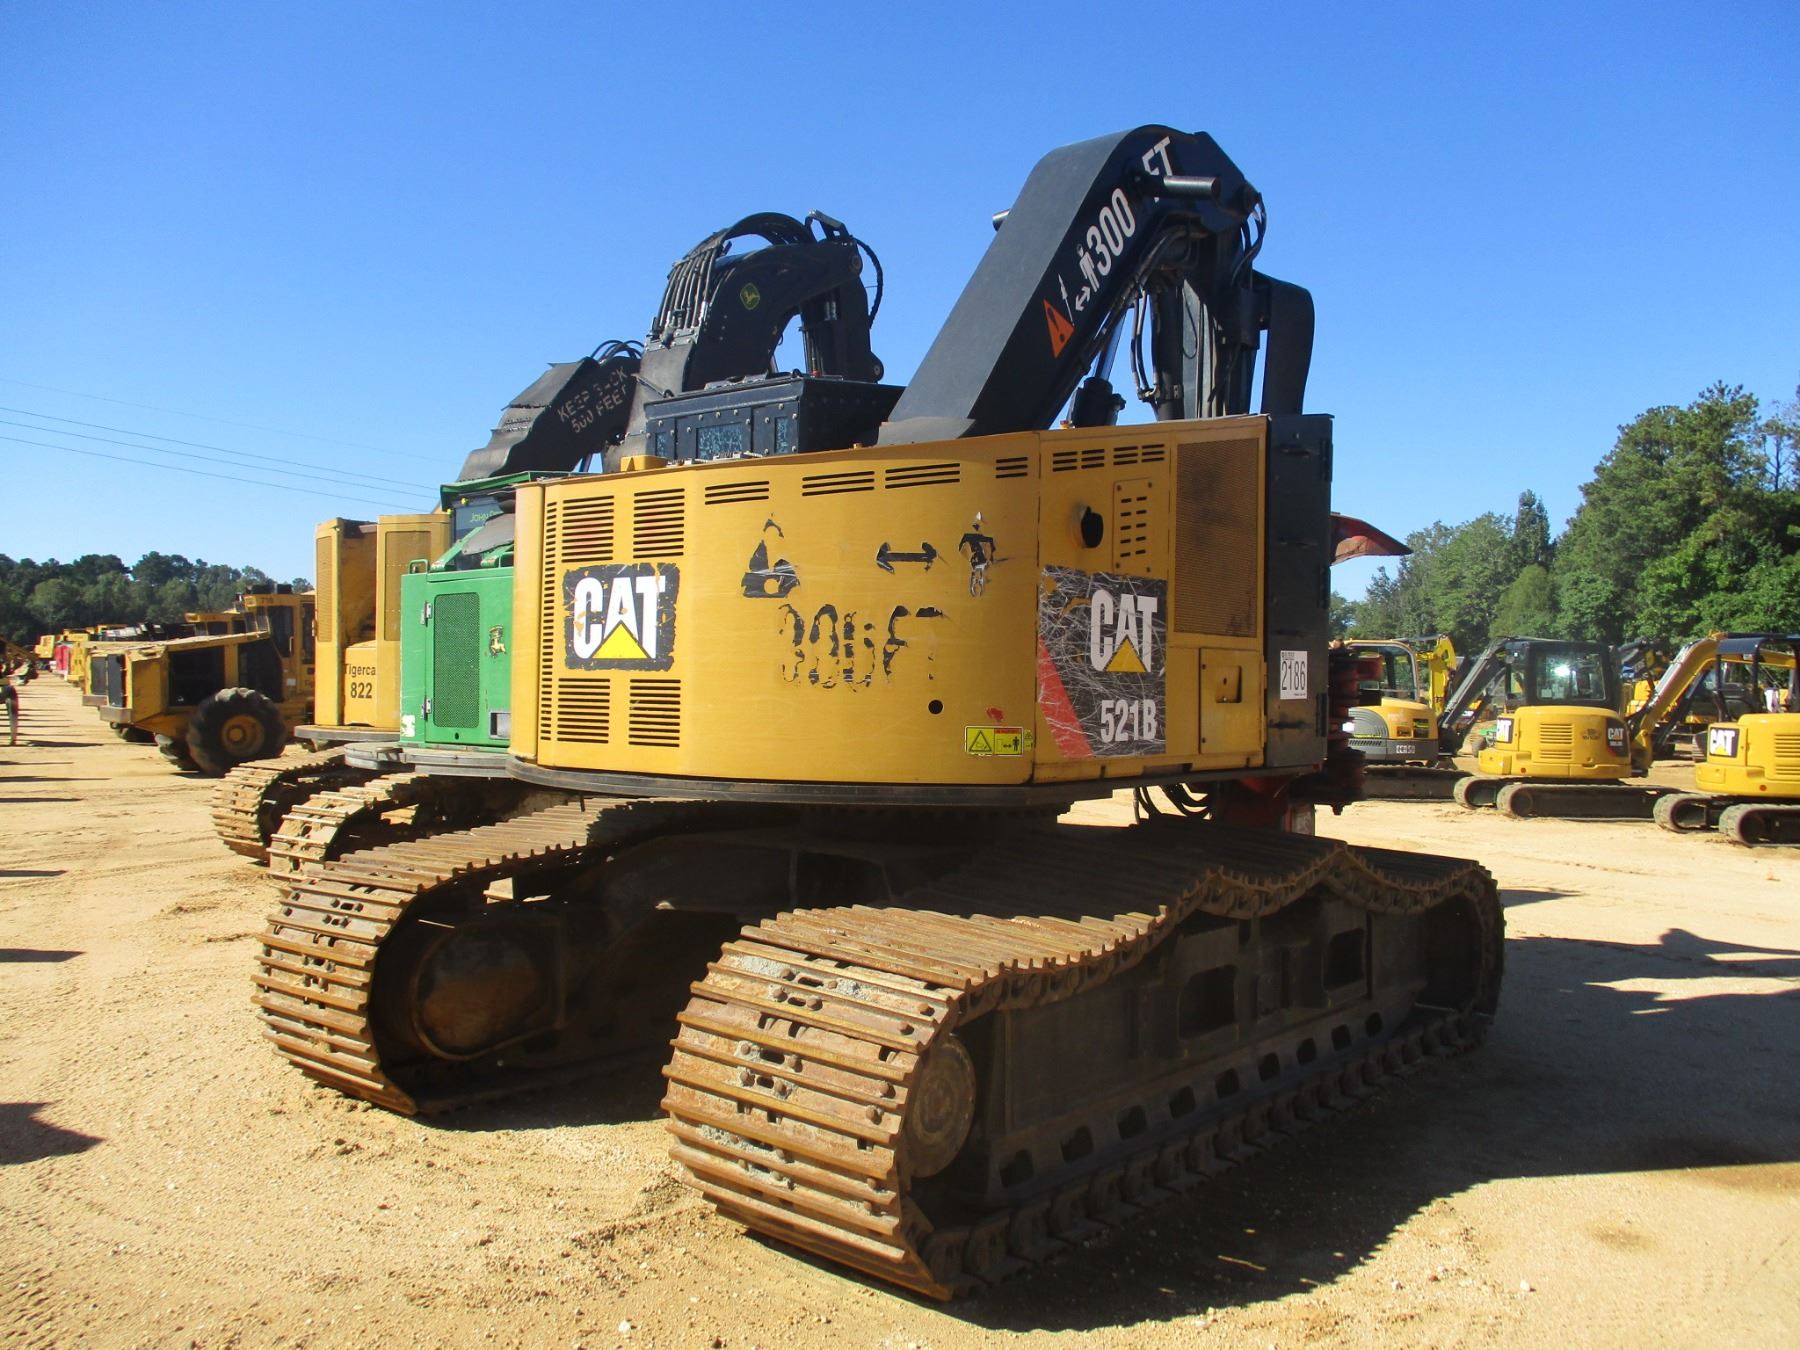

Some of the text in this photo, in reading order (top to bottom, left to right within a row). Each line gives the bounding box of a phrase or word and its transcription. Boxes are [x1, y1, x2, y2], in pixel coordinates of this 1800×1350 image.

[1086, 187, 1136, 277] 300
[573, 576, 666, 659] CAT
[1090, 589, 1158, 673] CAT
[345, 663, 376, 678] Tigerca
[1281, 660, 1306, 691] 2186
[350, 682, 373, 699] 822
[1100, 699, 1158, 743] 521B
[1607, 727, 1624, 741] CAT
[1710, 728, 1736, 757] CAT
